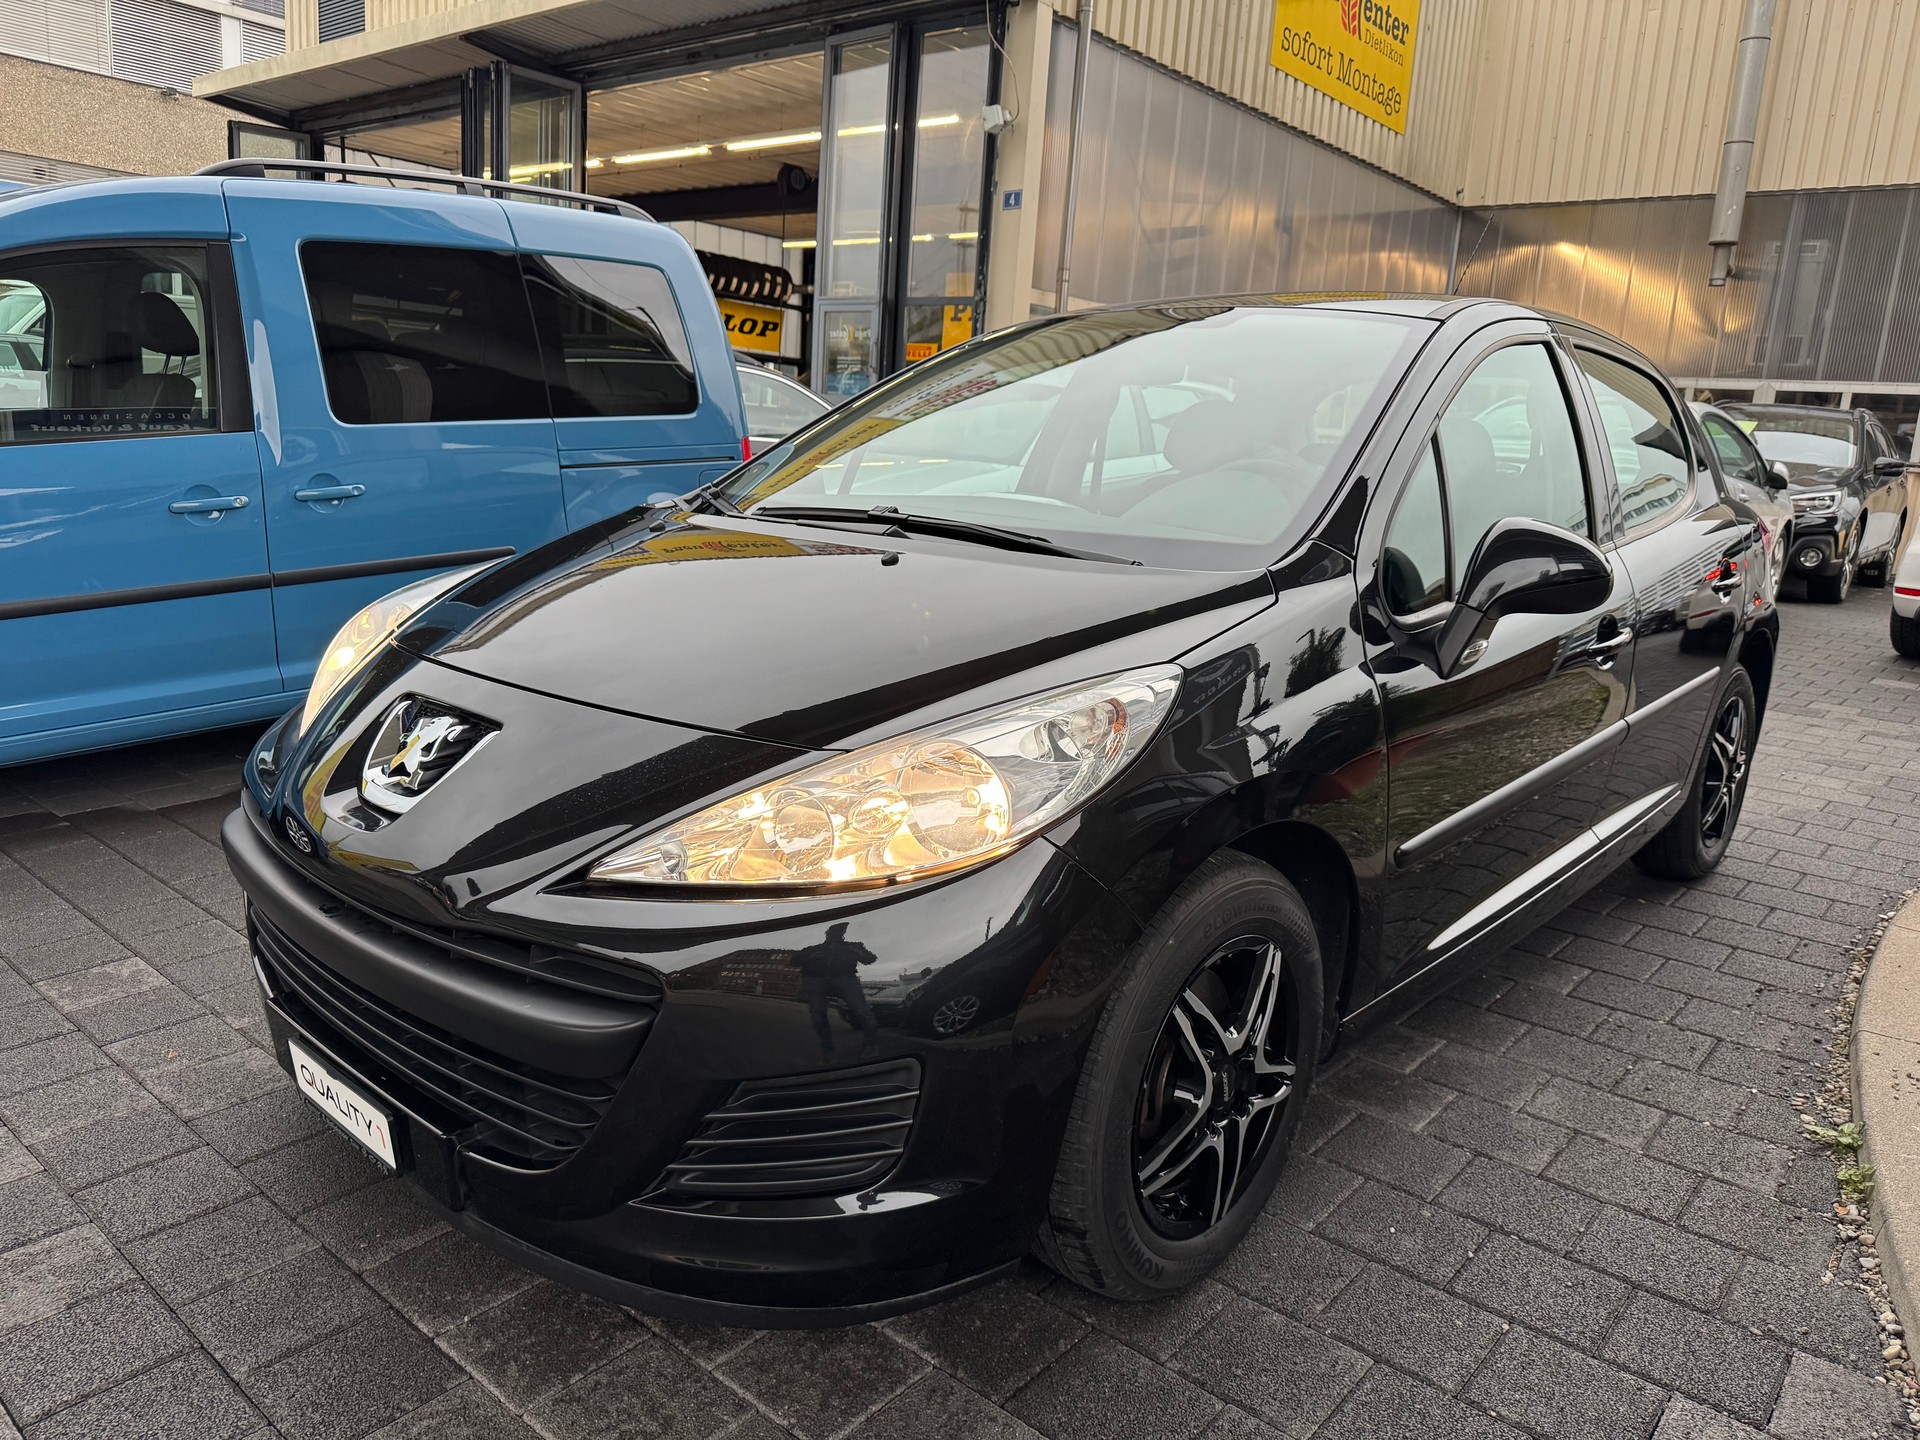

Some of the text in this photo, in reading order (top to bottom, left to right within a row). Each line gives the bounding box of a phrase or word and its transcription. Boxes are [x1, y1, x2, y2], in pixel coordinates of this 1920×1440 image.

[1363, 28, 1404, 67] Dietlikon
[1336, 52, 1402, 116] Montage
[1008, 192, 1016, 206] 4
[721, 312, 779, 338] LOP
[1116, 1210, 1165, 1282] KUMHO
